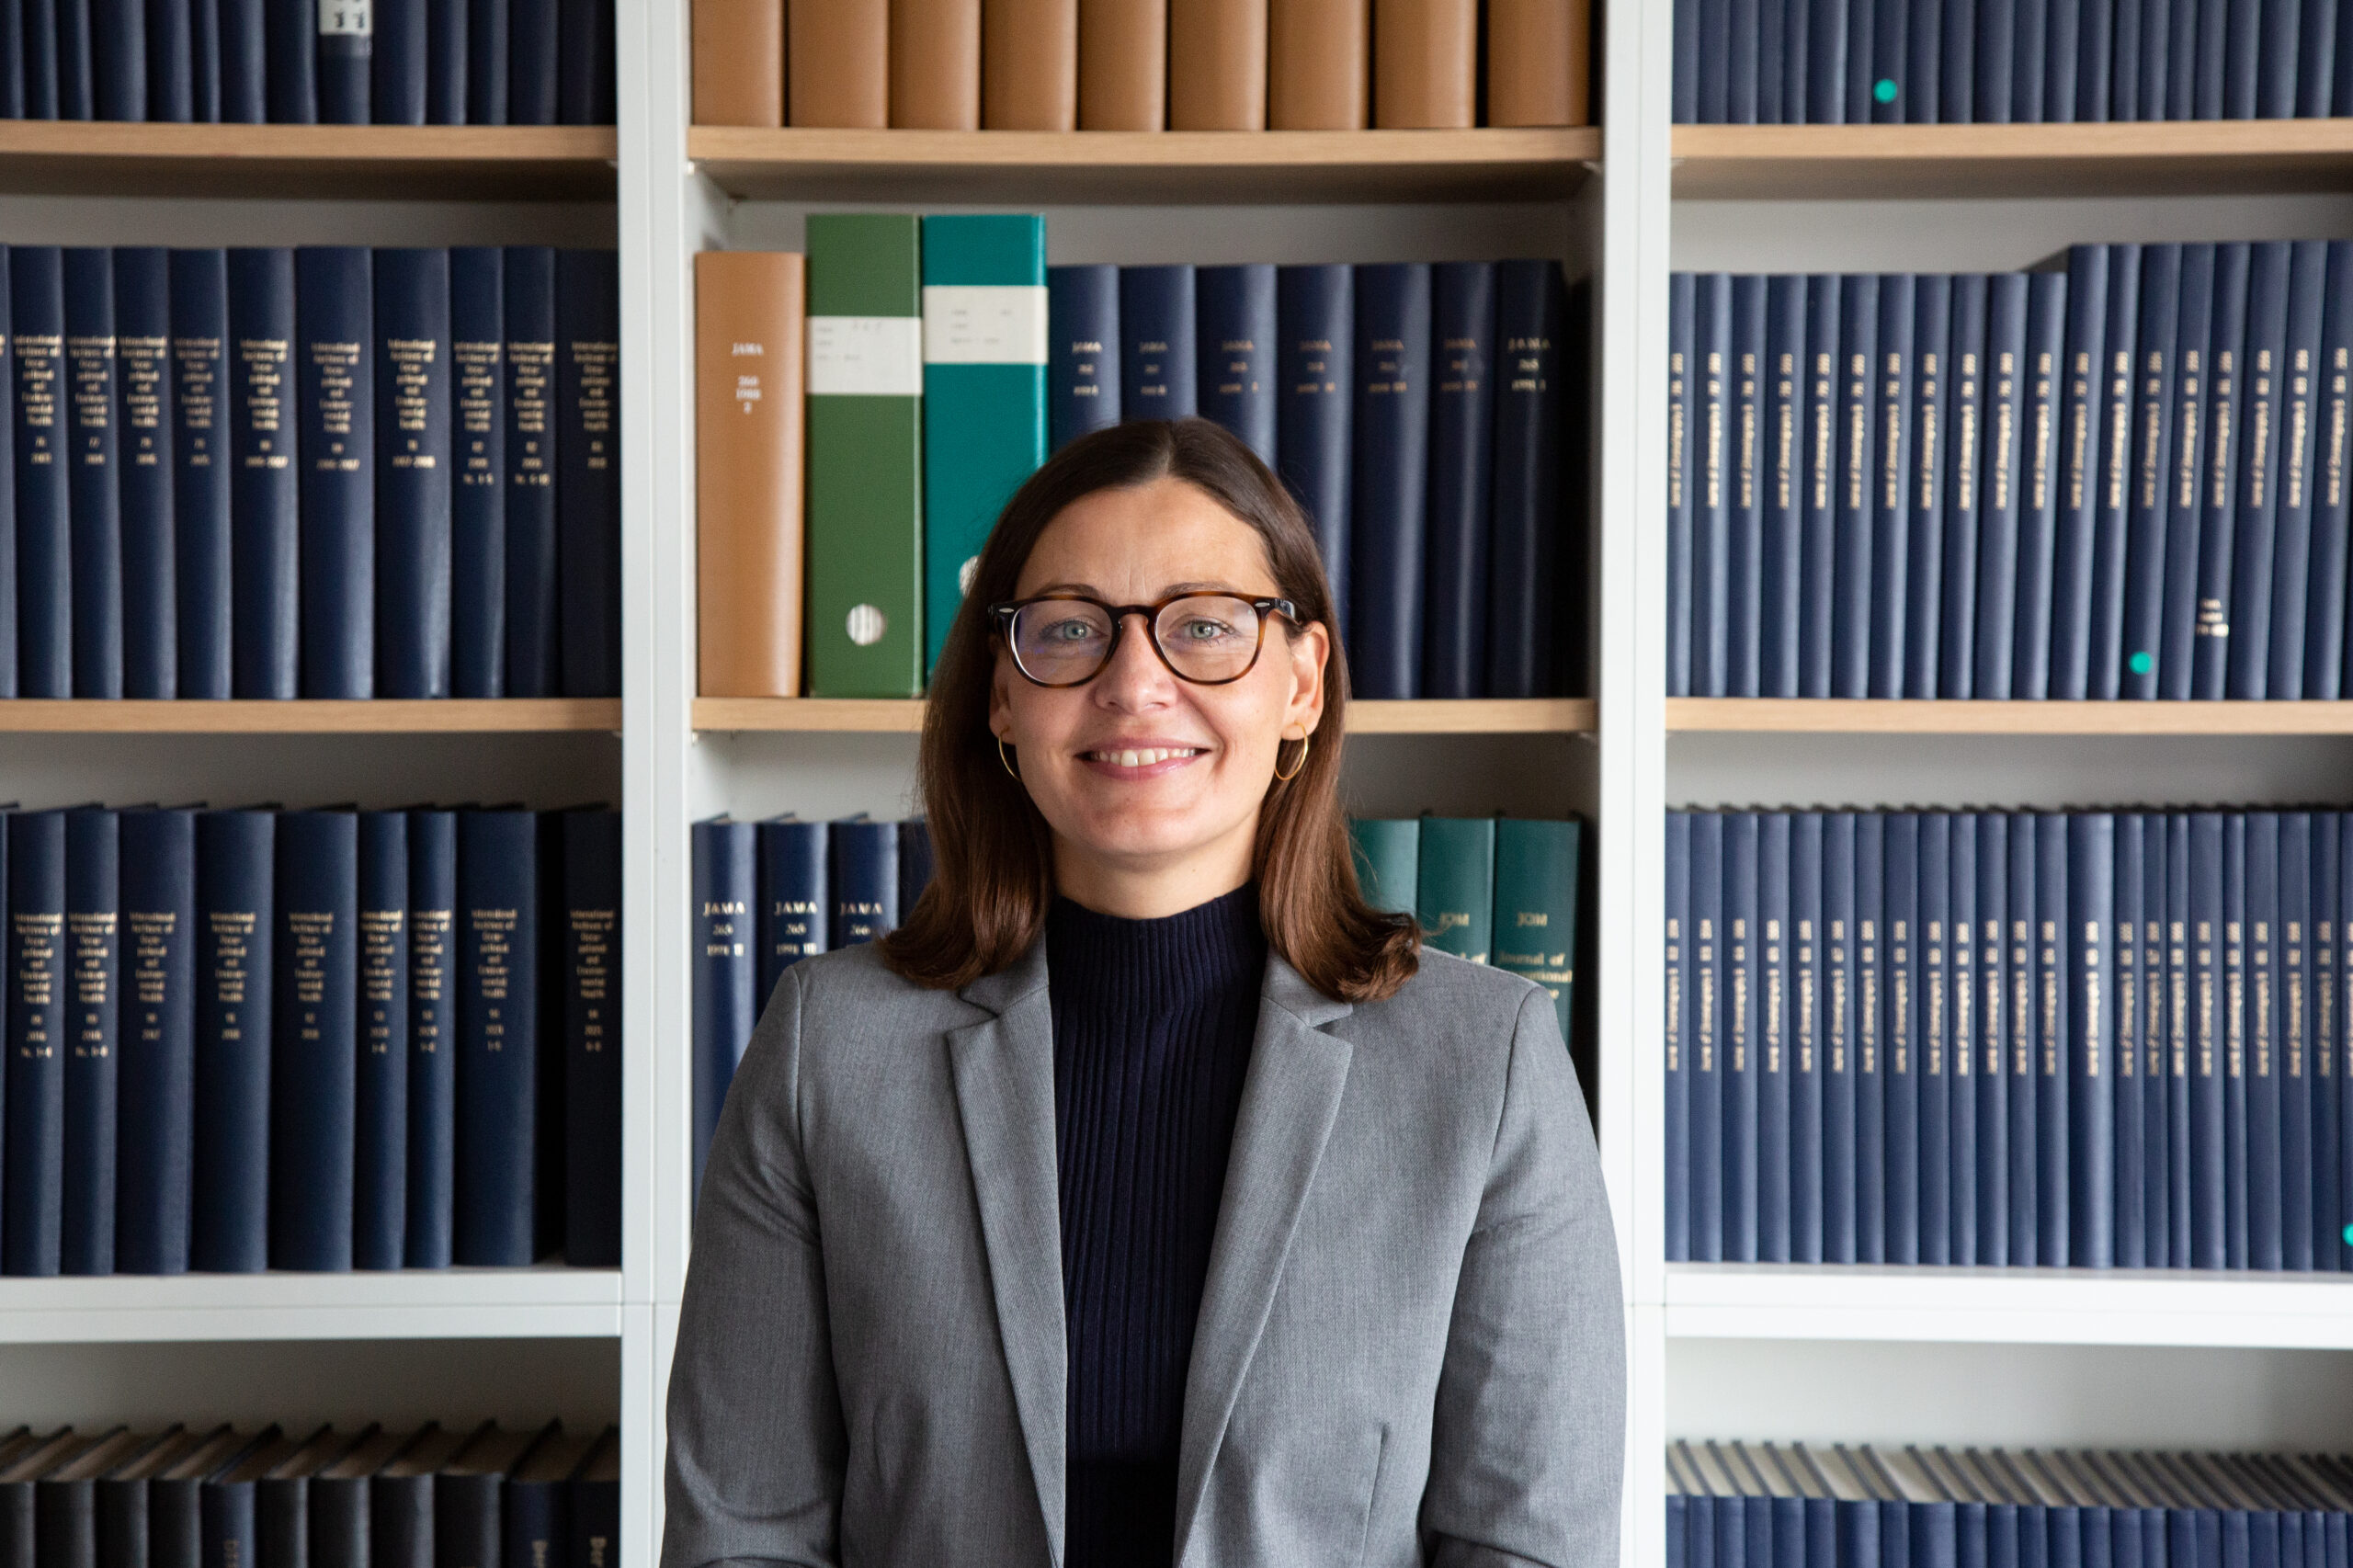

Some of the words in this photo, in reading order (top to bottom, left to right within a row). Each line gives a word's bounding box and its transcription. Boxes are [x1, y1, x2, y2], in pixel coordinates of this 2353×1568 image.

[732, 342, 764, 357] JAMA
[702, 901, 746, 917] JAMA
[774, 901, 818, 916] JAMA
[839, 902, 883, 917] JAMA
[1517, 911, 1548, 927] JOM
[1549, 952, 1565, 967] of
